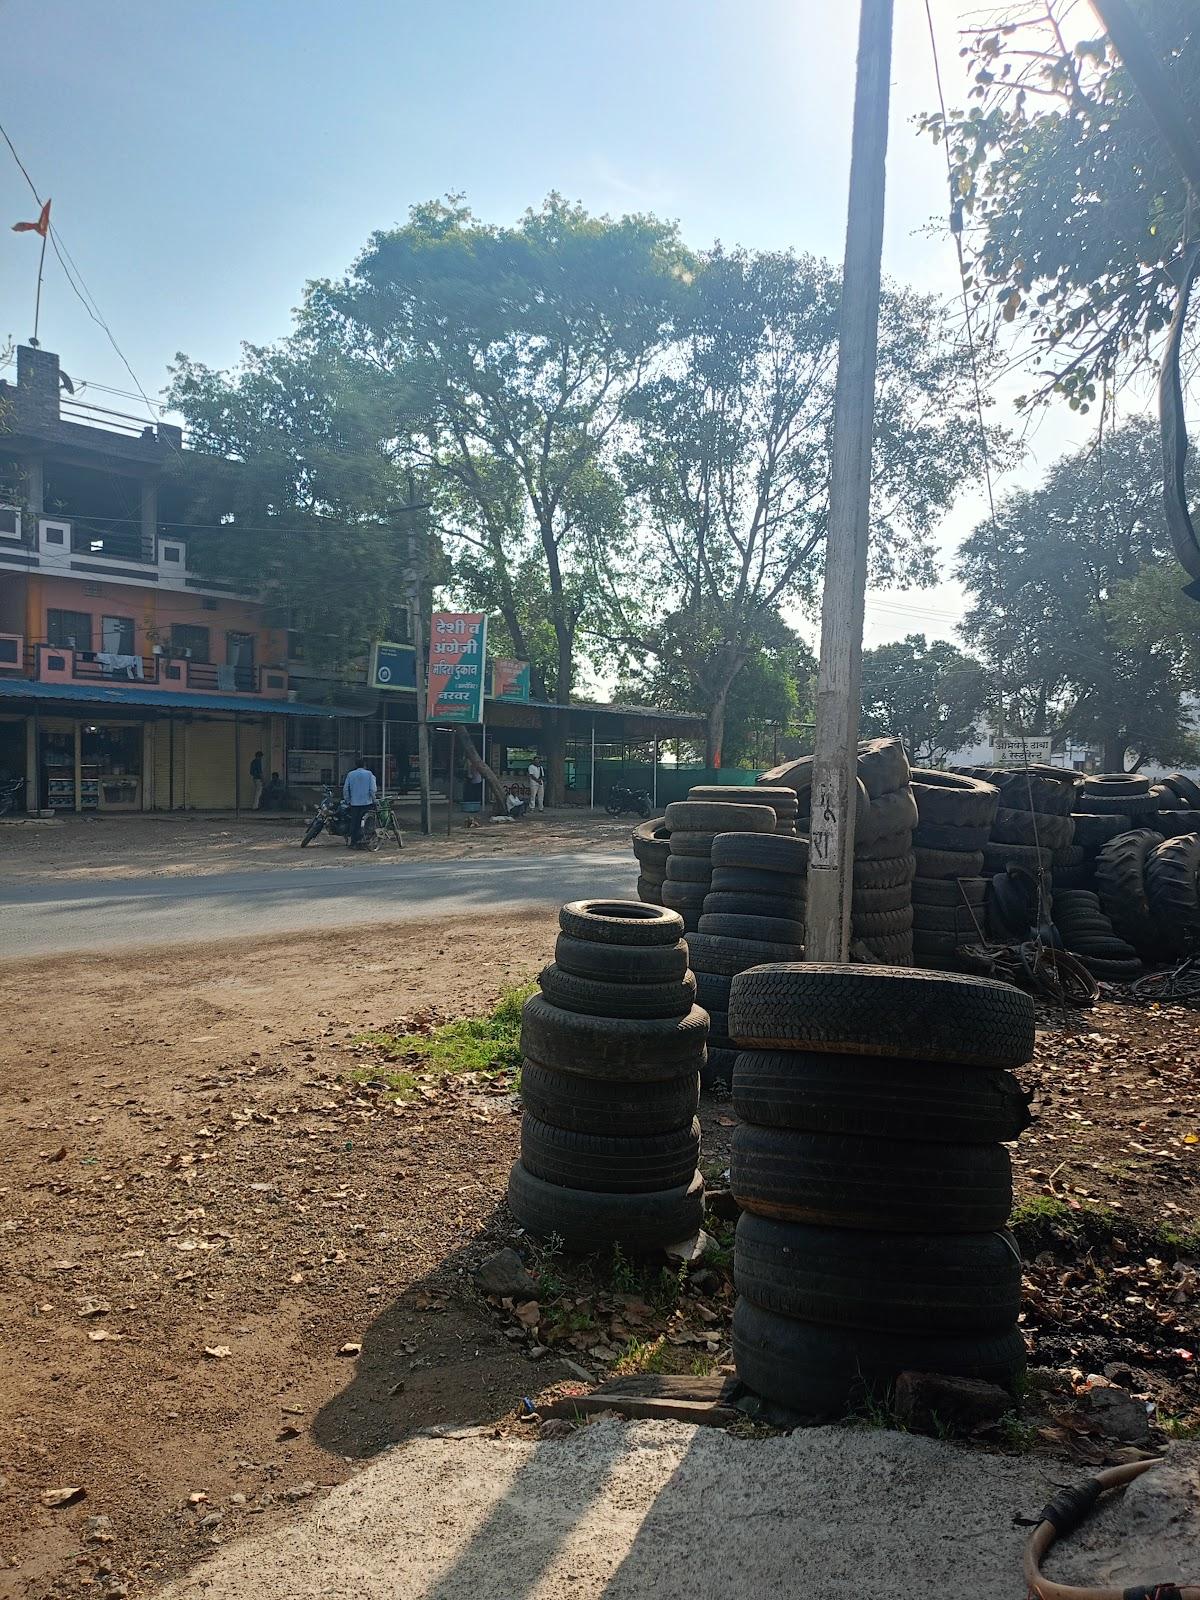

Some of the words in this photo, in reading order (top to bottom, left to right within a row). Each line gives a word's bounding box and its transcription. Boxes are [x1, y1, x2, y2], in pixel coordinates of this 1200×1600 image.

[436, 618, 465, 634] देशी
[469, 623, 480, 634] व
[433, 638, 479, 655] अंग्रेजी
[455, 664, 478, 680] दुकान
[438, 692, 470, 700] नरवर
